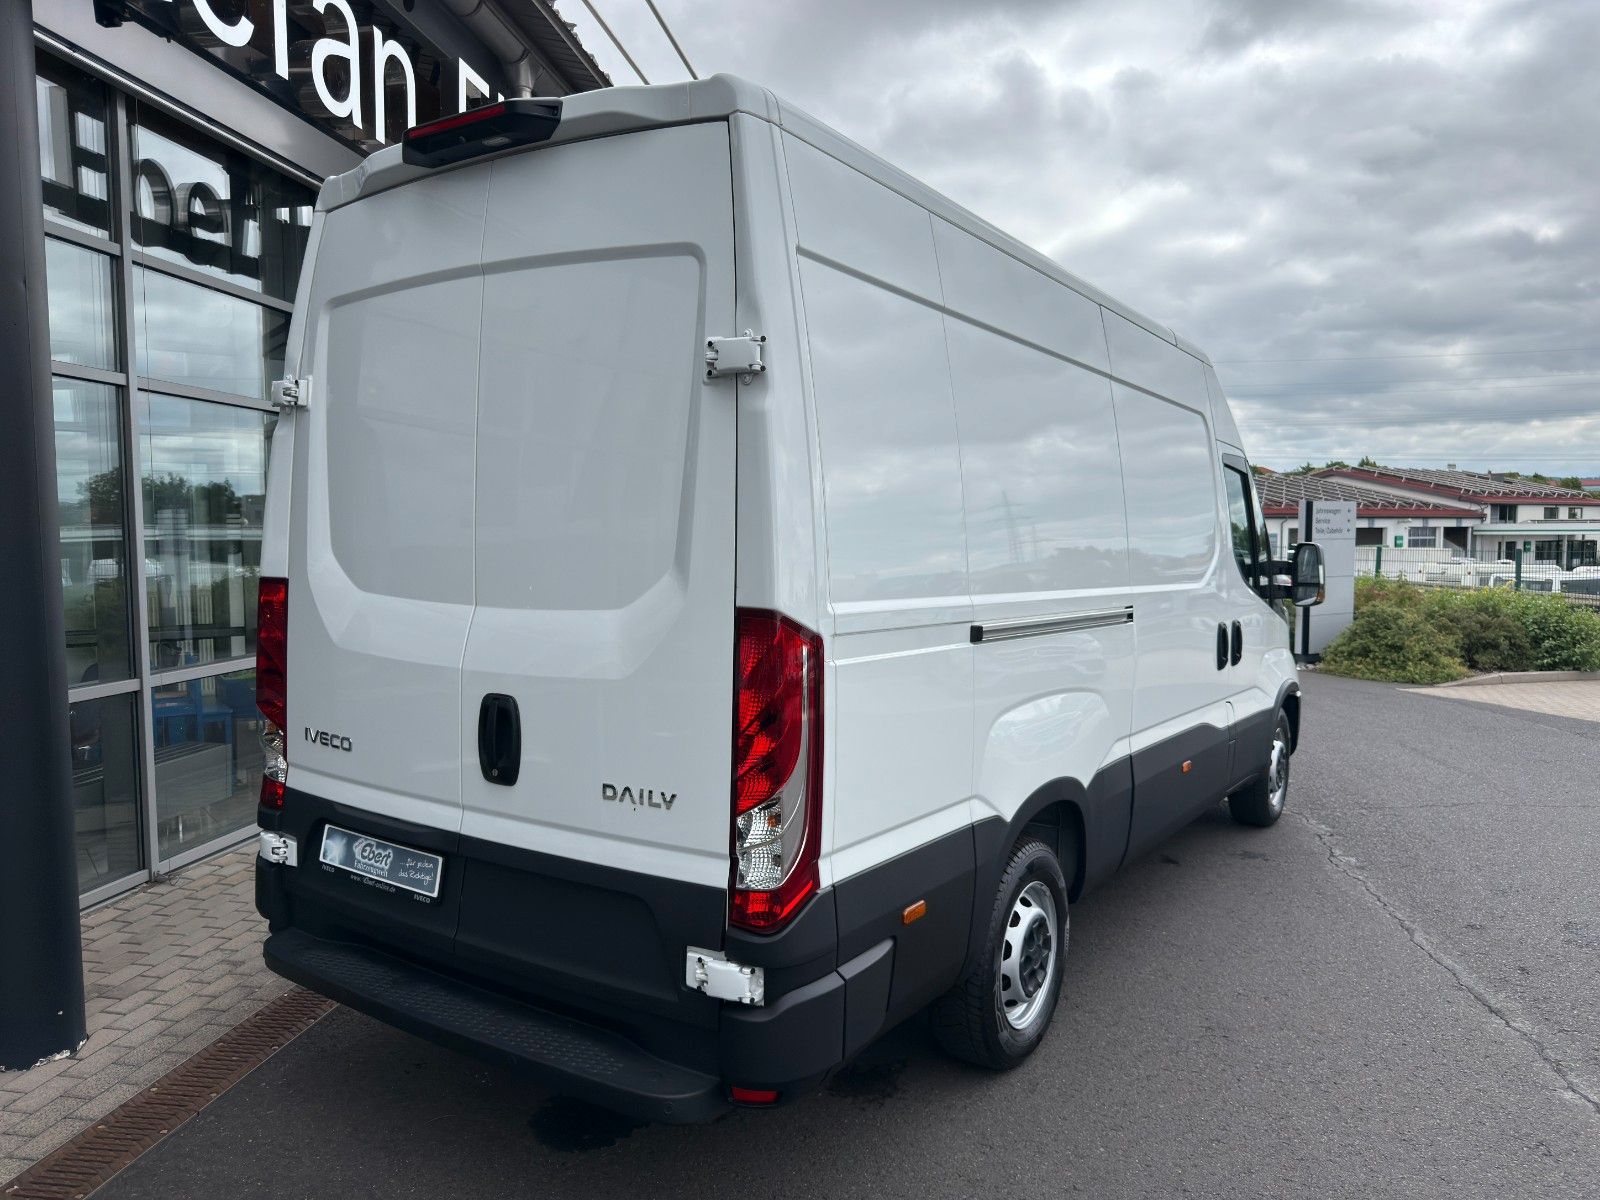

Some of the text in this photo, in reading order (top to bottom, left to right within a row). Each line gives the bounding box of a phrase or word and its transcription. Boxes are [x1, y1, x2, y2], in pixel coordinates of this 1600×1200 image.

[305, 726, 352, 752] IVECO
[602, 783, 677, 809] DAILY
[360, 842, 391, 867] Ebert
[321, 864, 335, 873] IVECO
[413, 893, 431, 904] IVECO
